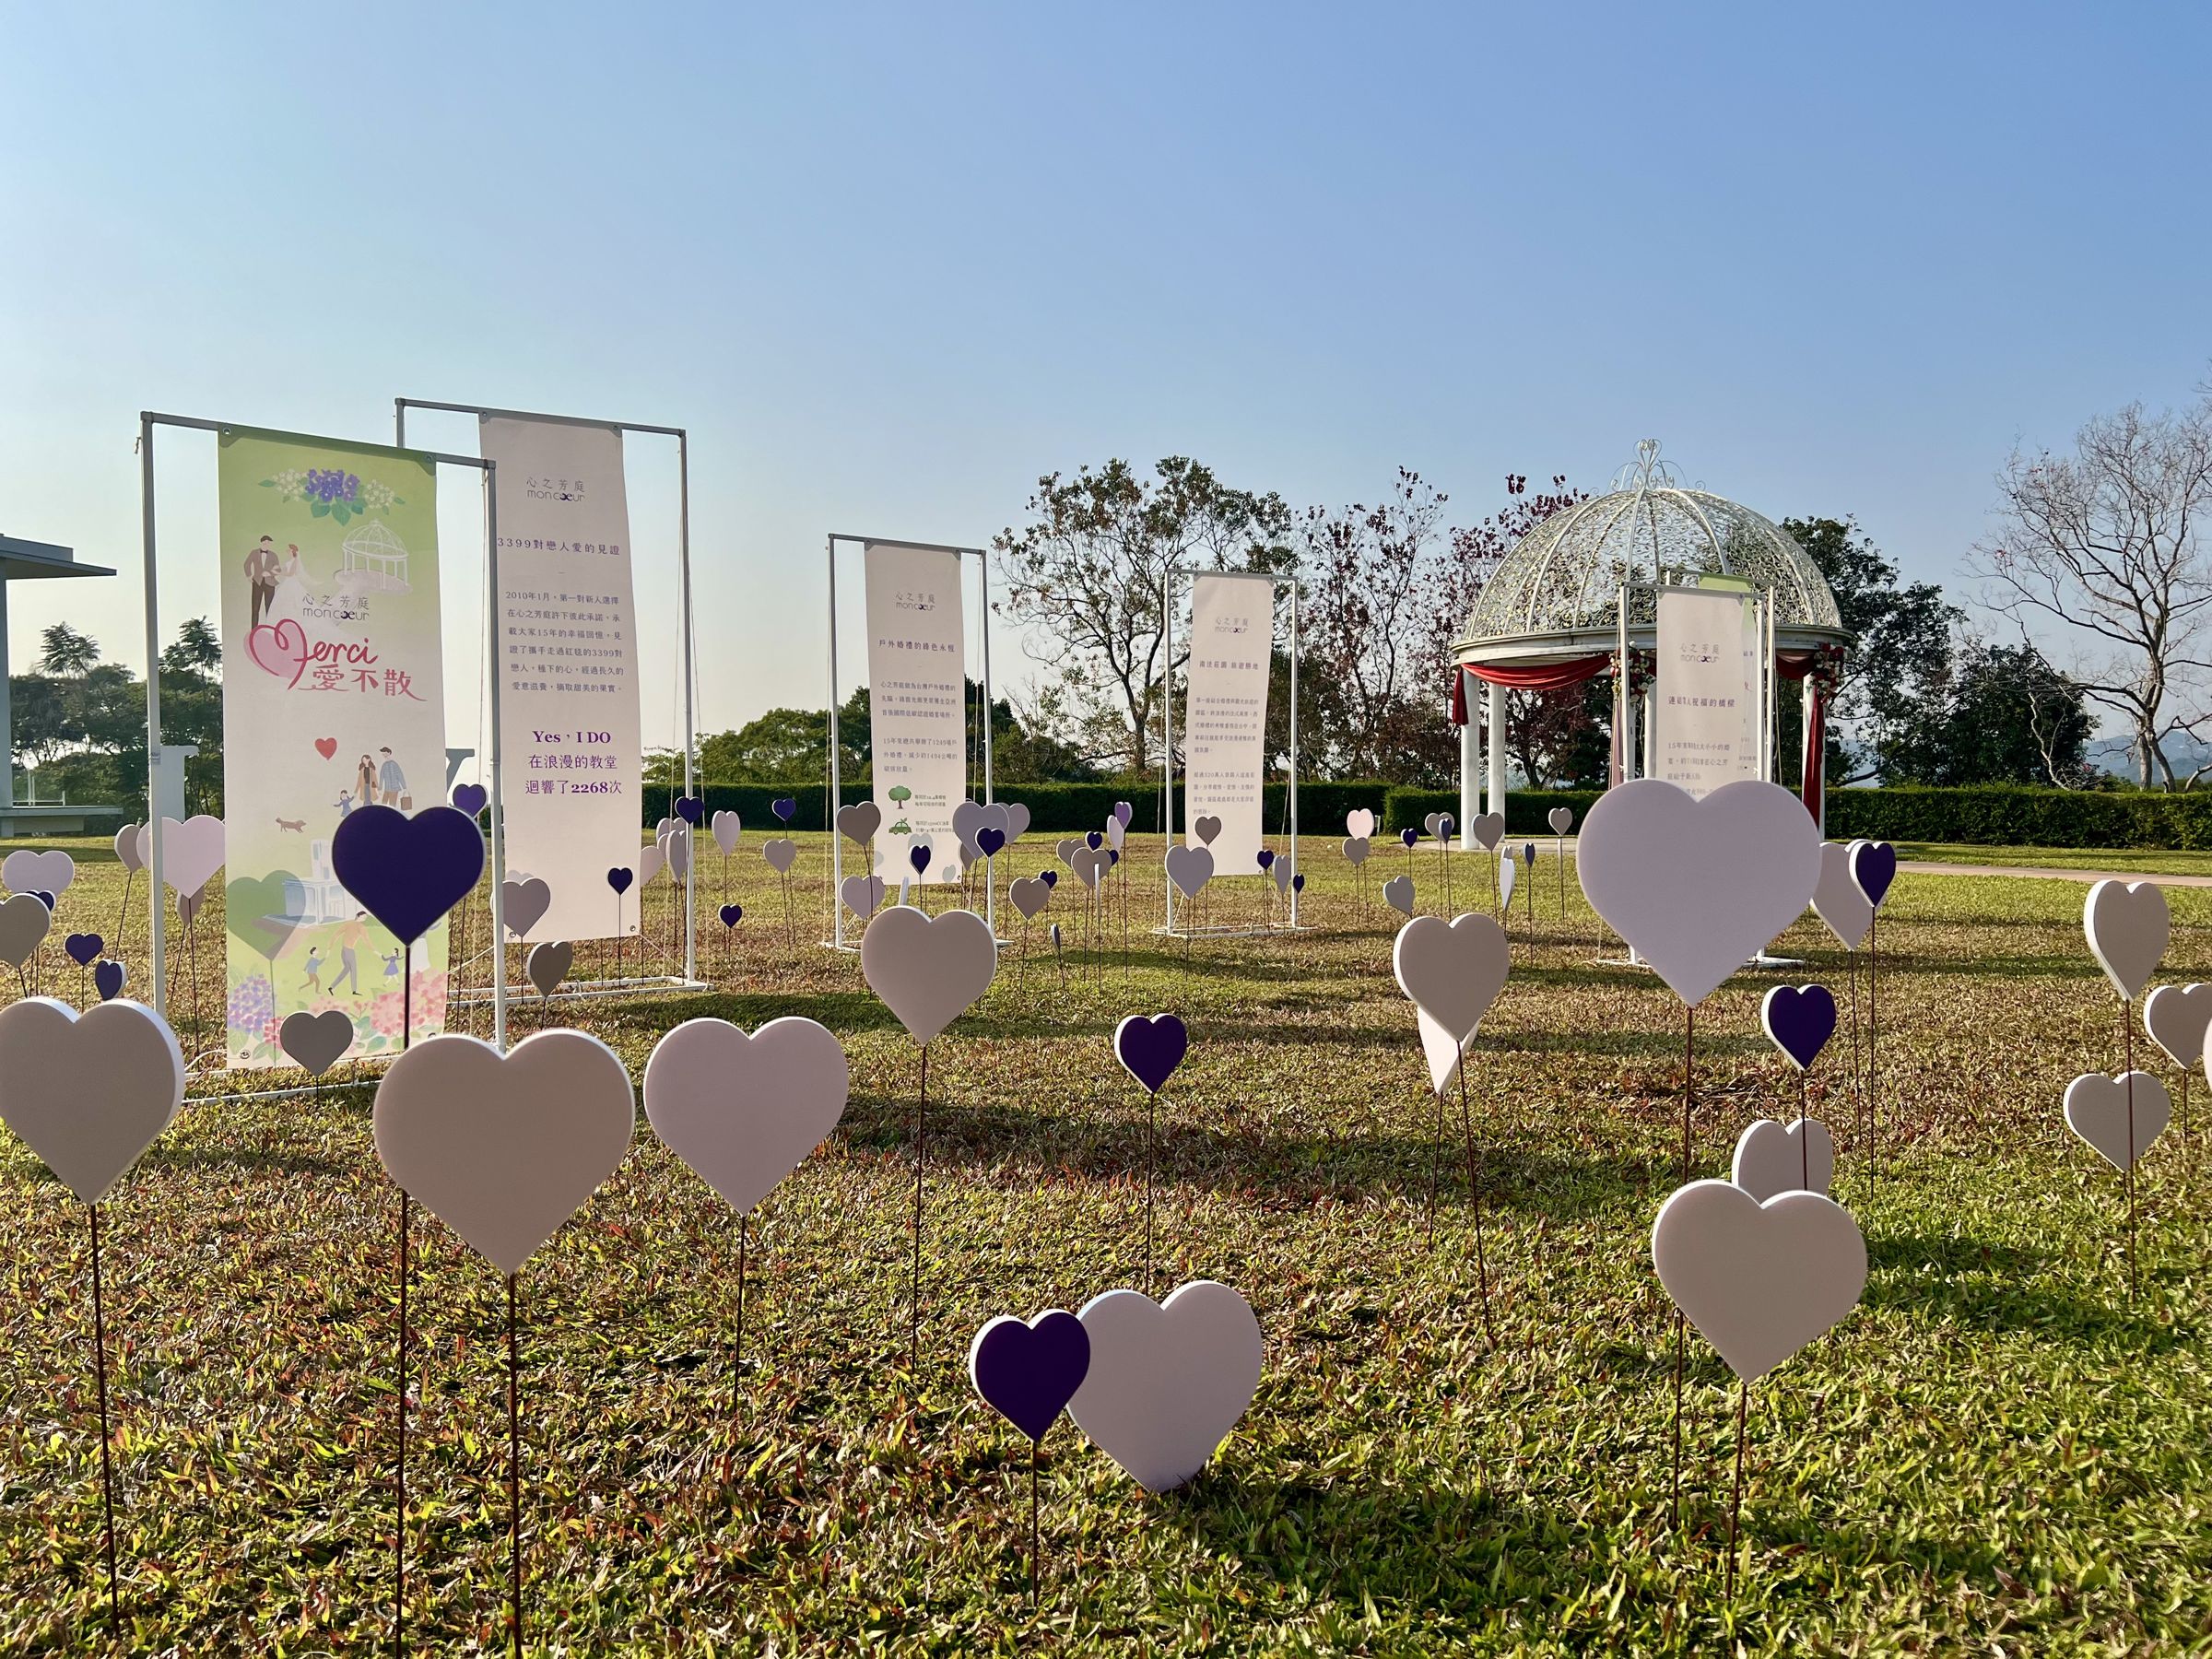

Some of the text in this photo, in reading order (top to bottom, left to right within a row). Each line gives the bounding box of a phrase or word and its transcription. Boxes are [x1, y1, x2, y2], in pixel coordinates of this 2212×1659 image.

[526, 477, 585, 492] 心之芳庭
[497, 537, 620, 556] 3399對戀人愛的見證
[301, 594, 369, 610] 心之芳庭
[299, 664, 428, 702] 愛不散
[528, 754, 618, 770] 在浪漫的教堂
[524, 780, 623, 795] 迴響了2268次
